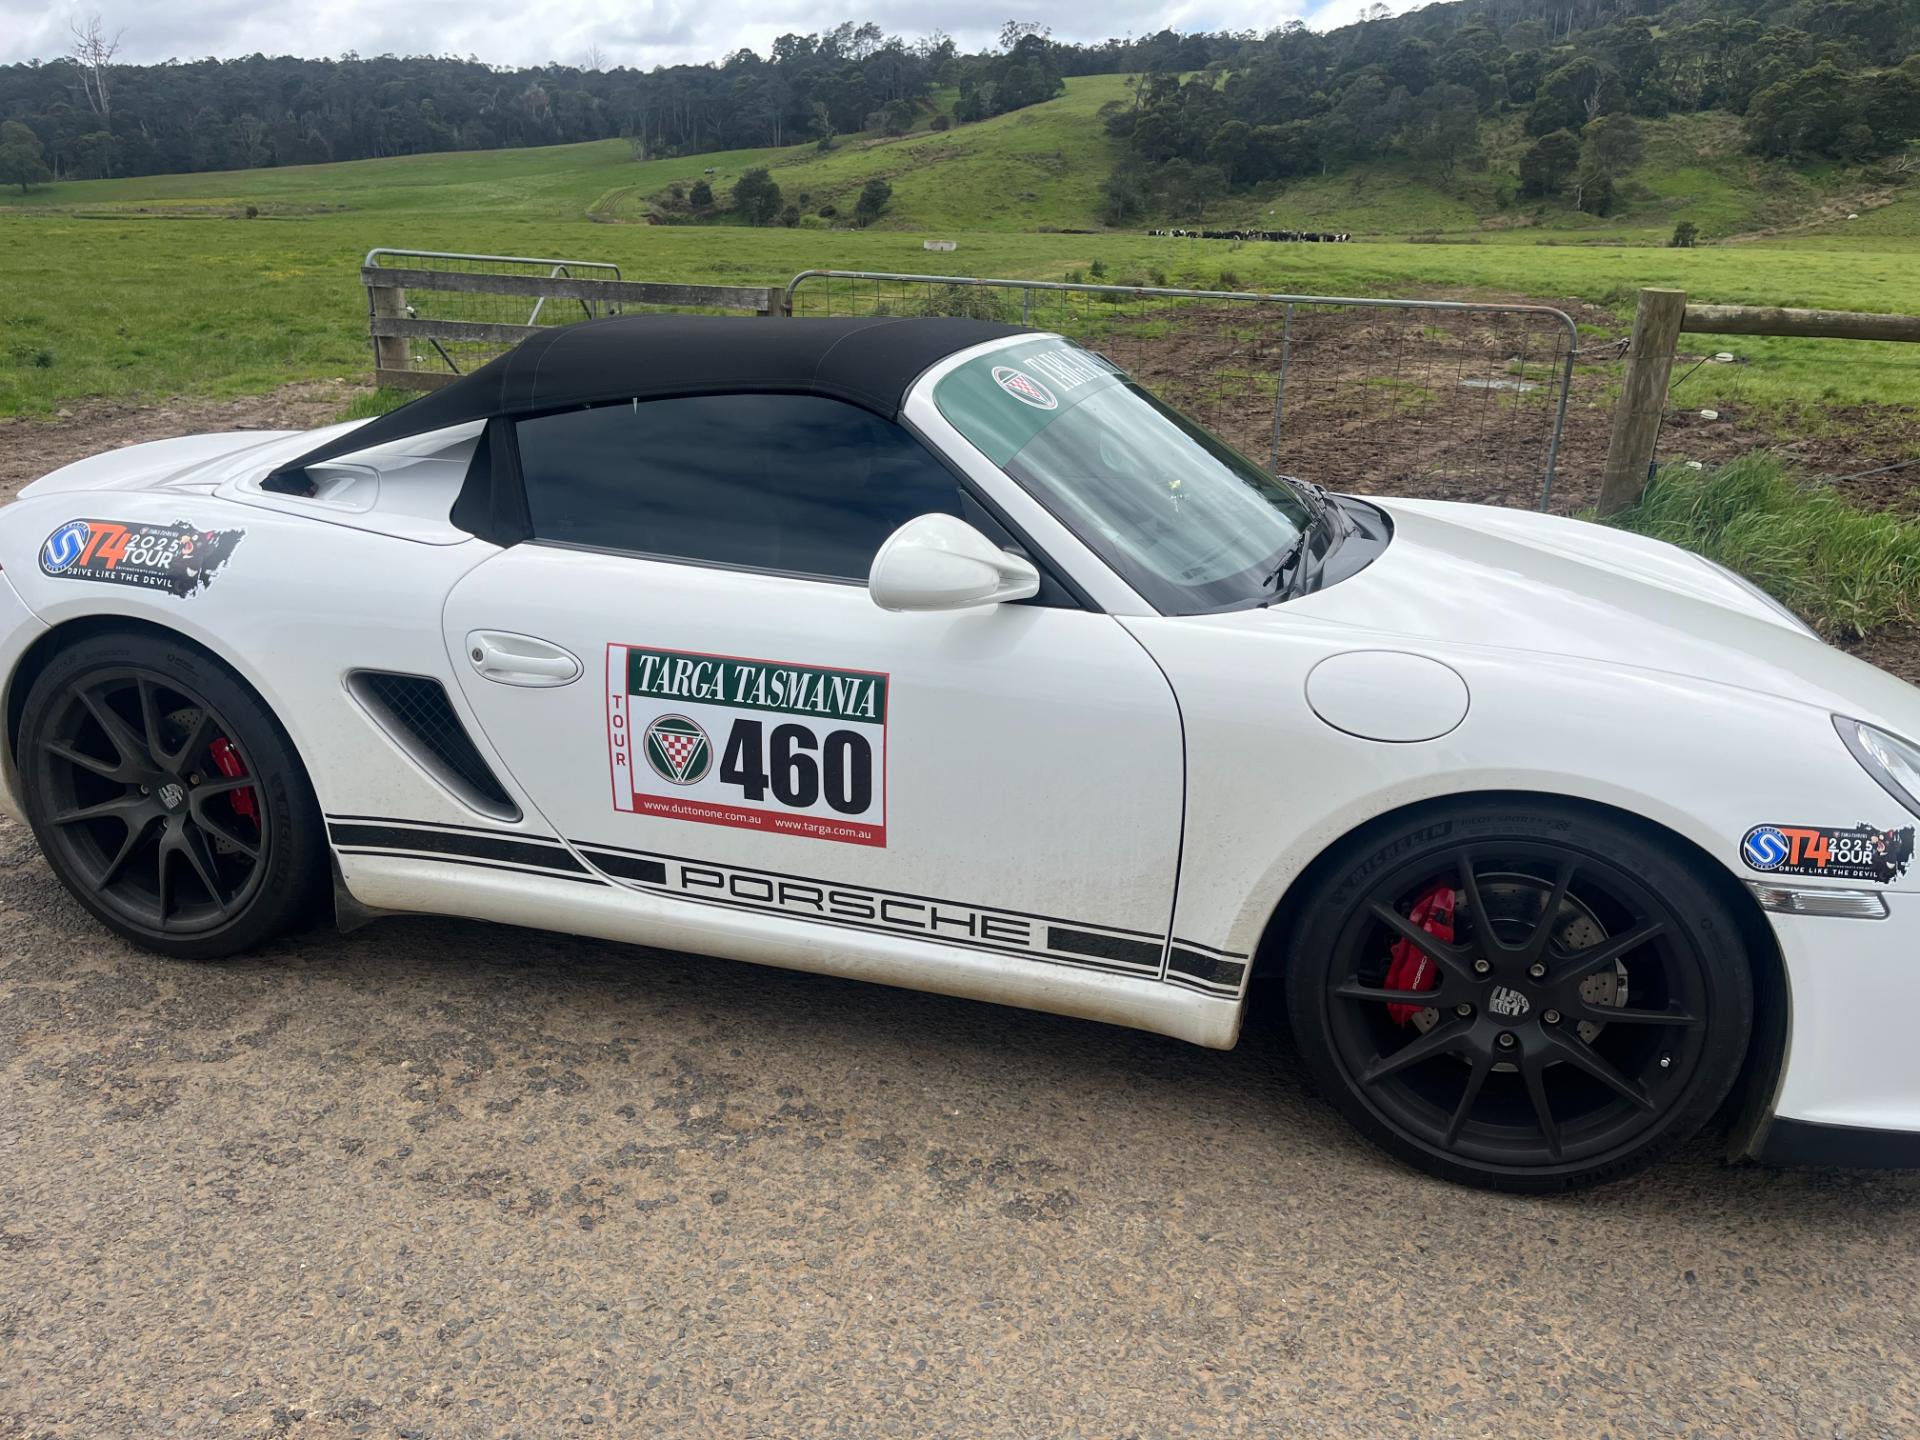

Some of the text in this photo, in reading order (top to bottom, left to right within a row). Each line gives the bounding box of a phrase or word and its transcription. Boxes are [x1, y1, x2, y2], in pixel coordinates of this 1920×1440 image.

[127, 534, 179, 552] 2025
[122, 546, 174, 569] TOUR
[67, 567, 92, 577] DRIVE
[96, 570, 116, 579] LIKE
[121, 573, 138, 582] THE
[143, 576, 173, 588] DEVIL
[639, 655, 876, 717] TARGA TASMANIA
[612, 695, 626, 766] TOUR
[719, 718, 872, 815] 460
[644, 800, 872, 840] www.duttonone.com.au www.targa.com.au
[1829, 838, 1873, 851] 2025
[1828, 849, 1873, 865] TOUR
[1778, 865, 1805, 873] DRIVE
[1808, 867, 1828, 875] LIKE
[1852, 870, 1878, 878] DEVIL
[680, 866, 1031, 946] PORSCHE
